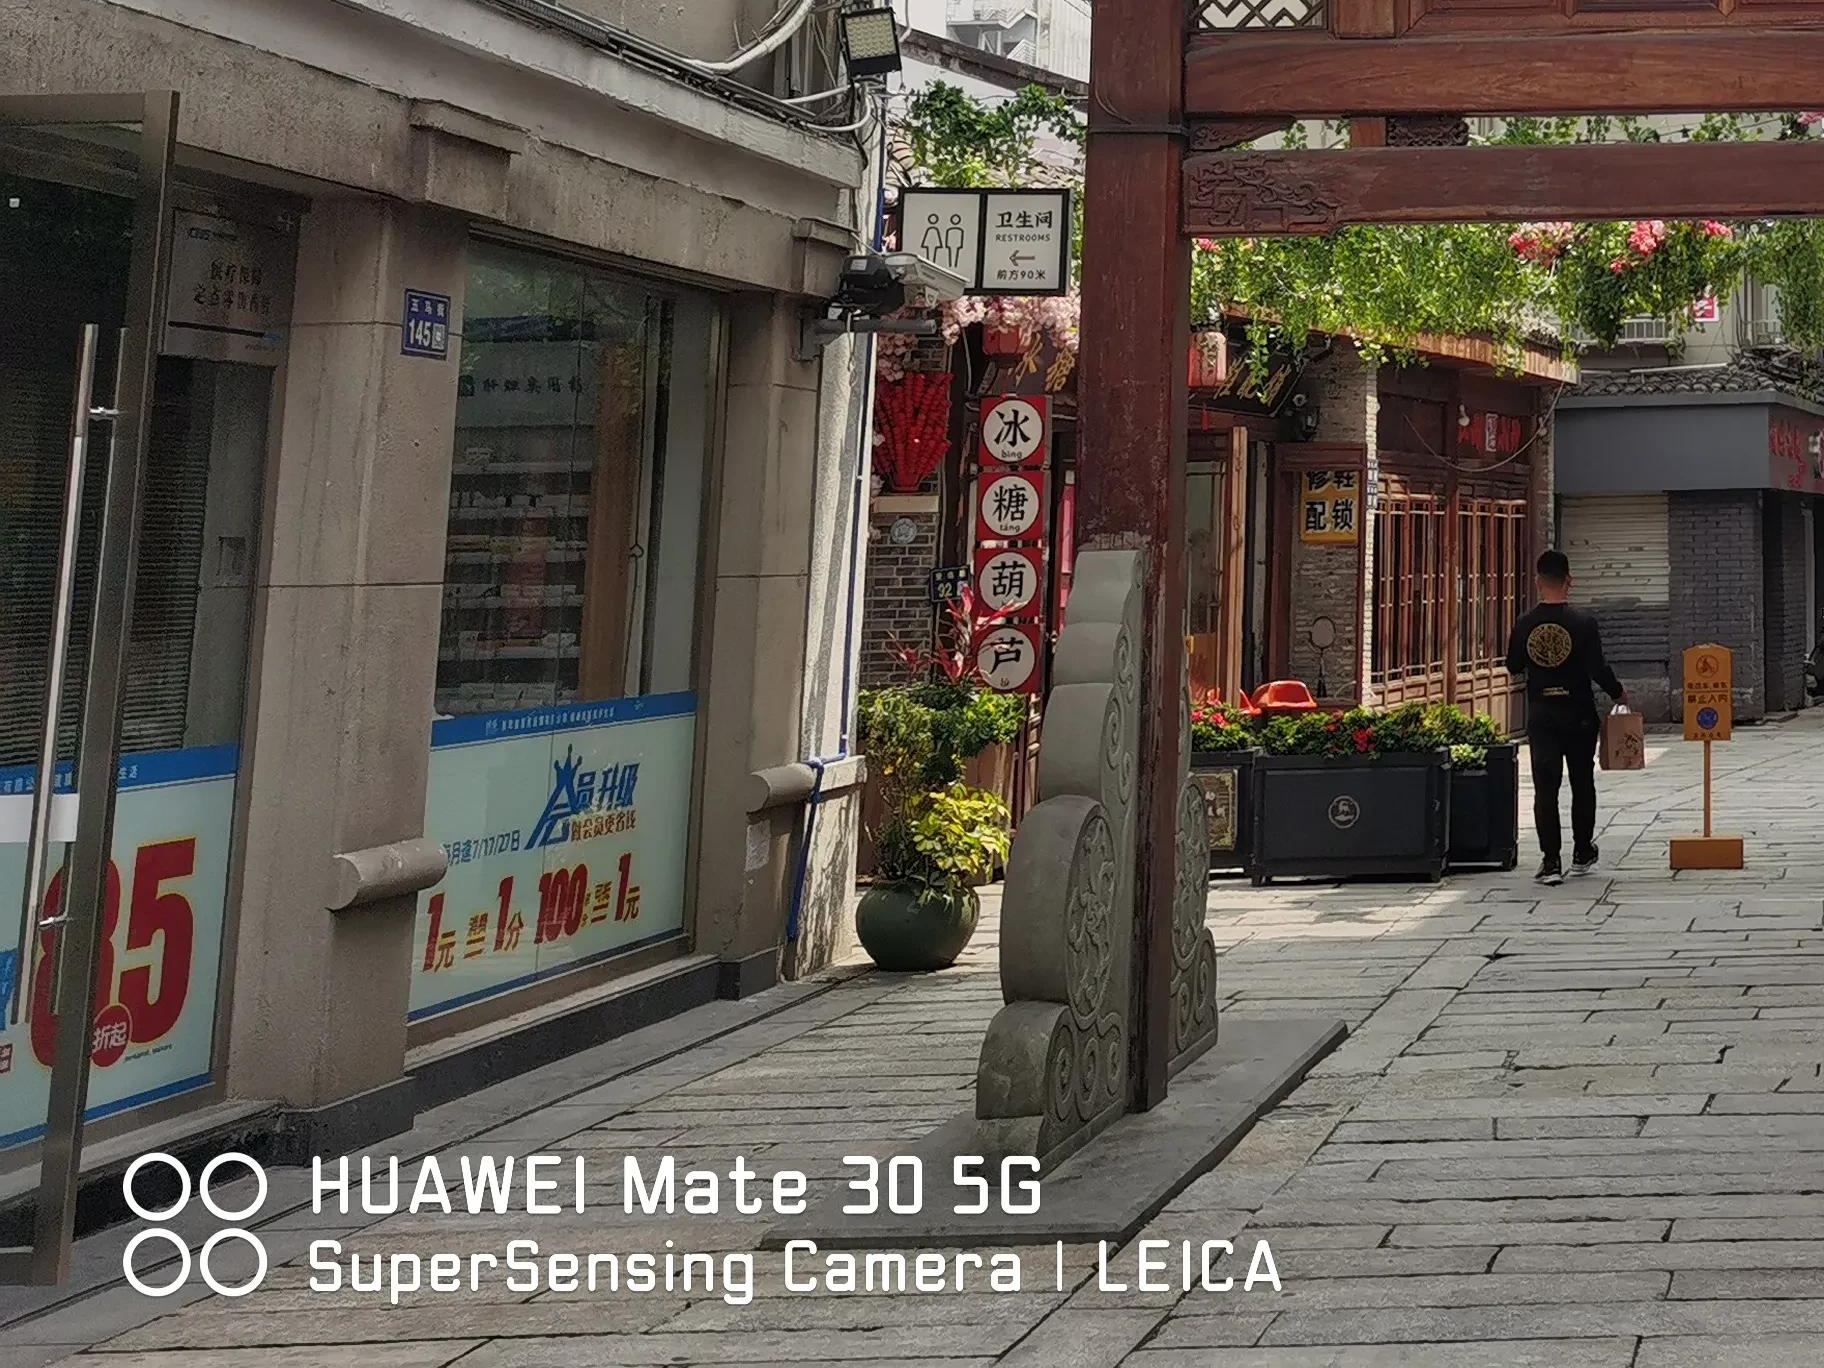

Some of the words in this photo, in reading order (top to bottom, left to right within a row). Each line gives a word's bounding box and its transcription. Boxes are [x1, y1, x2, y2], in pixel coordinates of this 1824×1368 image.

[995, 210, 1053, 229] 卫生间
[995, 233, 1051, 243] RESTROOMS
[996, 269, 1047, 281] 前方90米
[408, 318, 432, 347] 145
[1305, 498, 1354, 530] 配锁
